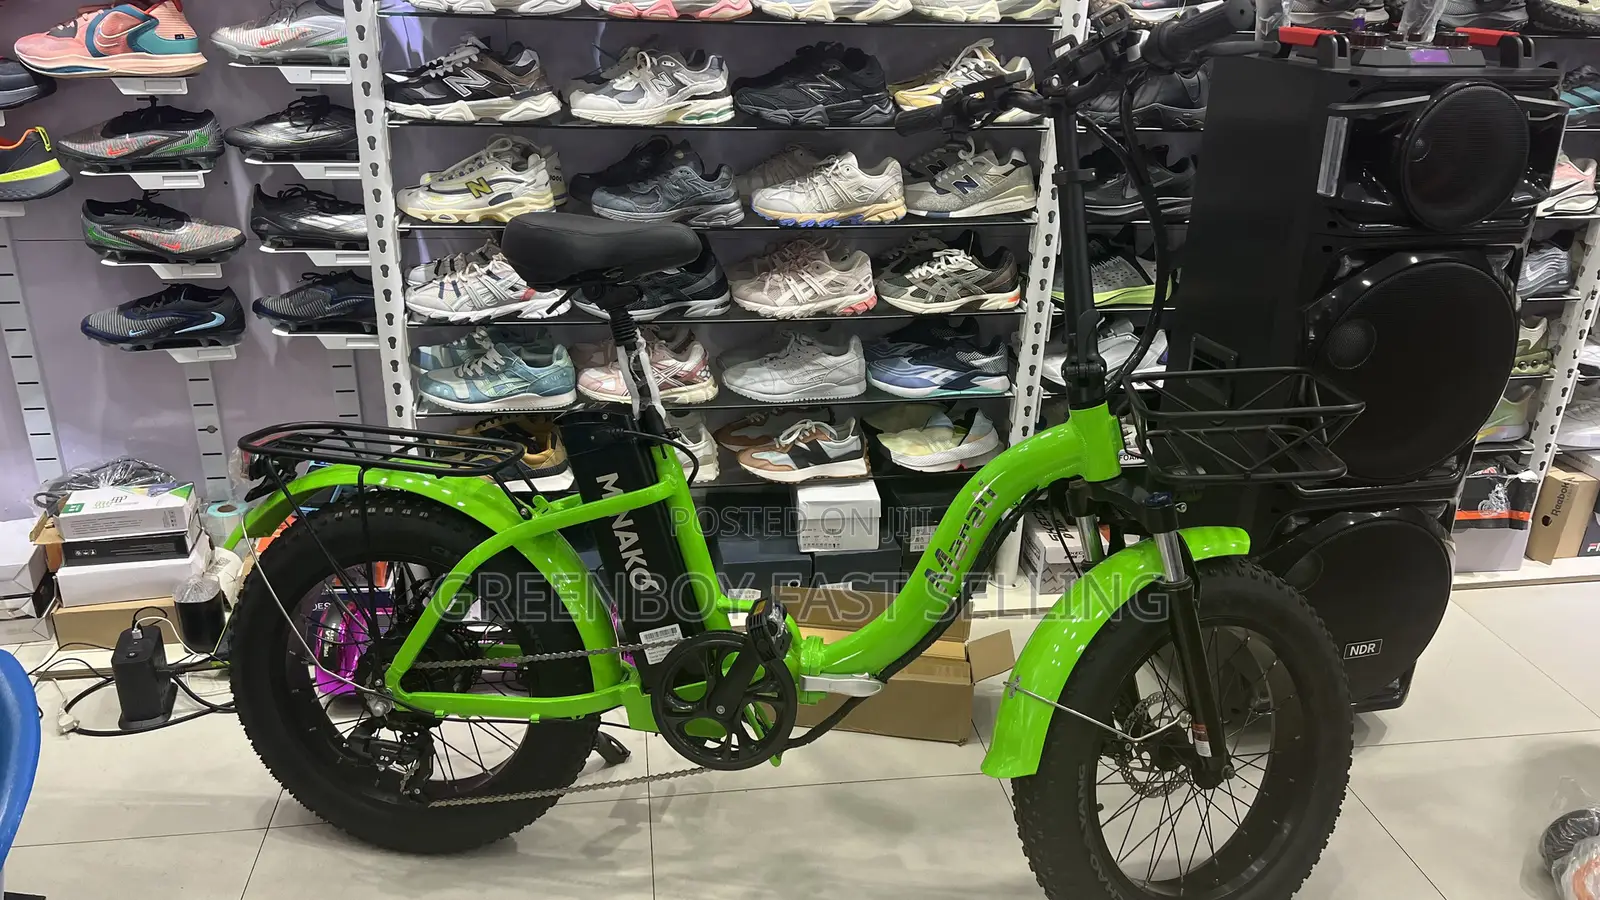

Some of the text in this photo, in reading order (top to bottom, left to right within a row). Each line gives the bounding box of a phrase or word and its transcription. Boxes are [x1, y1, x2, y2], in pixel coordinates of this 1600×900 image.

[443, 67, 491, 97] N
[650, 71, 676, 94] N
[465, 176, 494, 199] N
[952, 173, 980, 195] N
[596, 472, 661, 591] MNAKO
[1350, 643, 1376, 656] NDR
